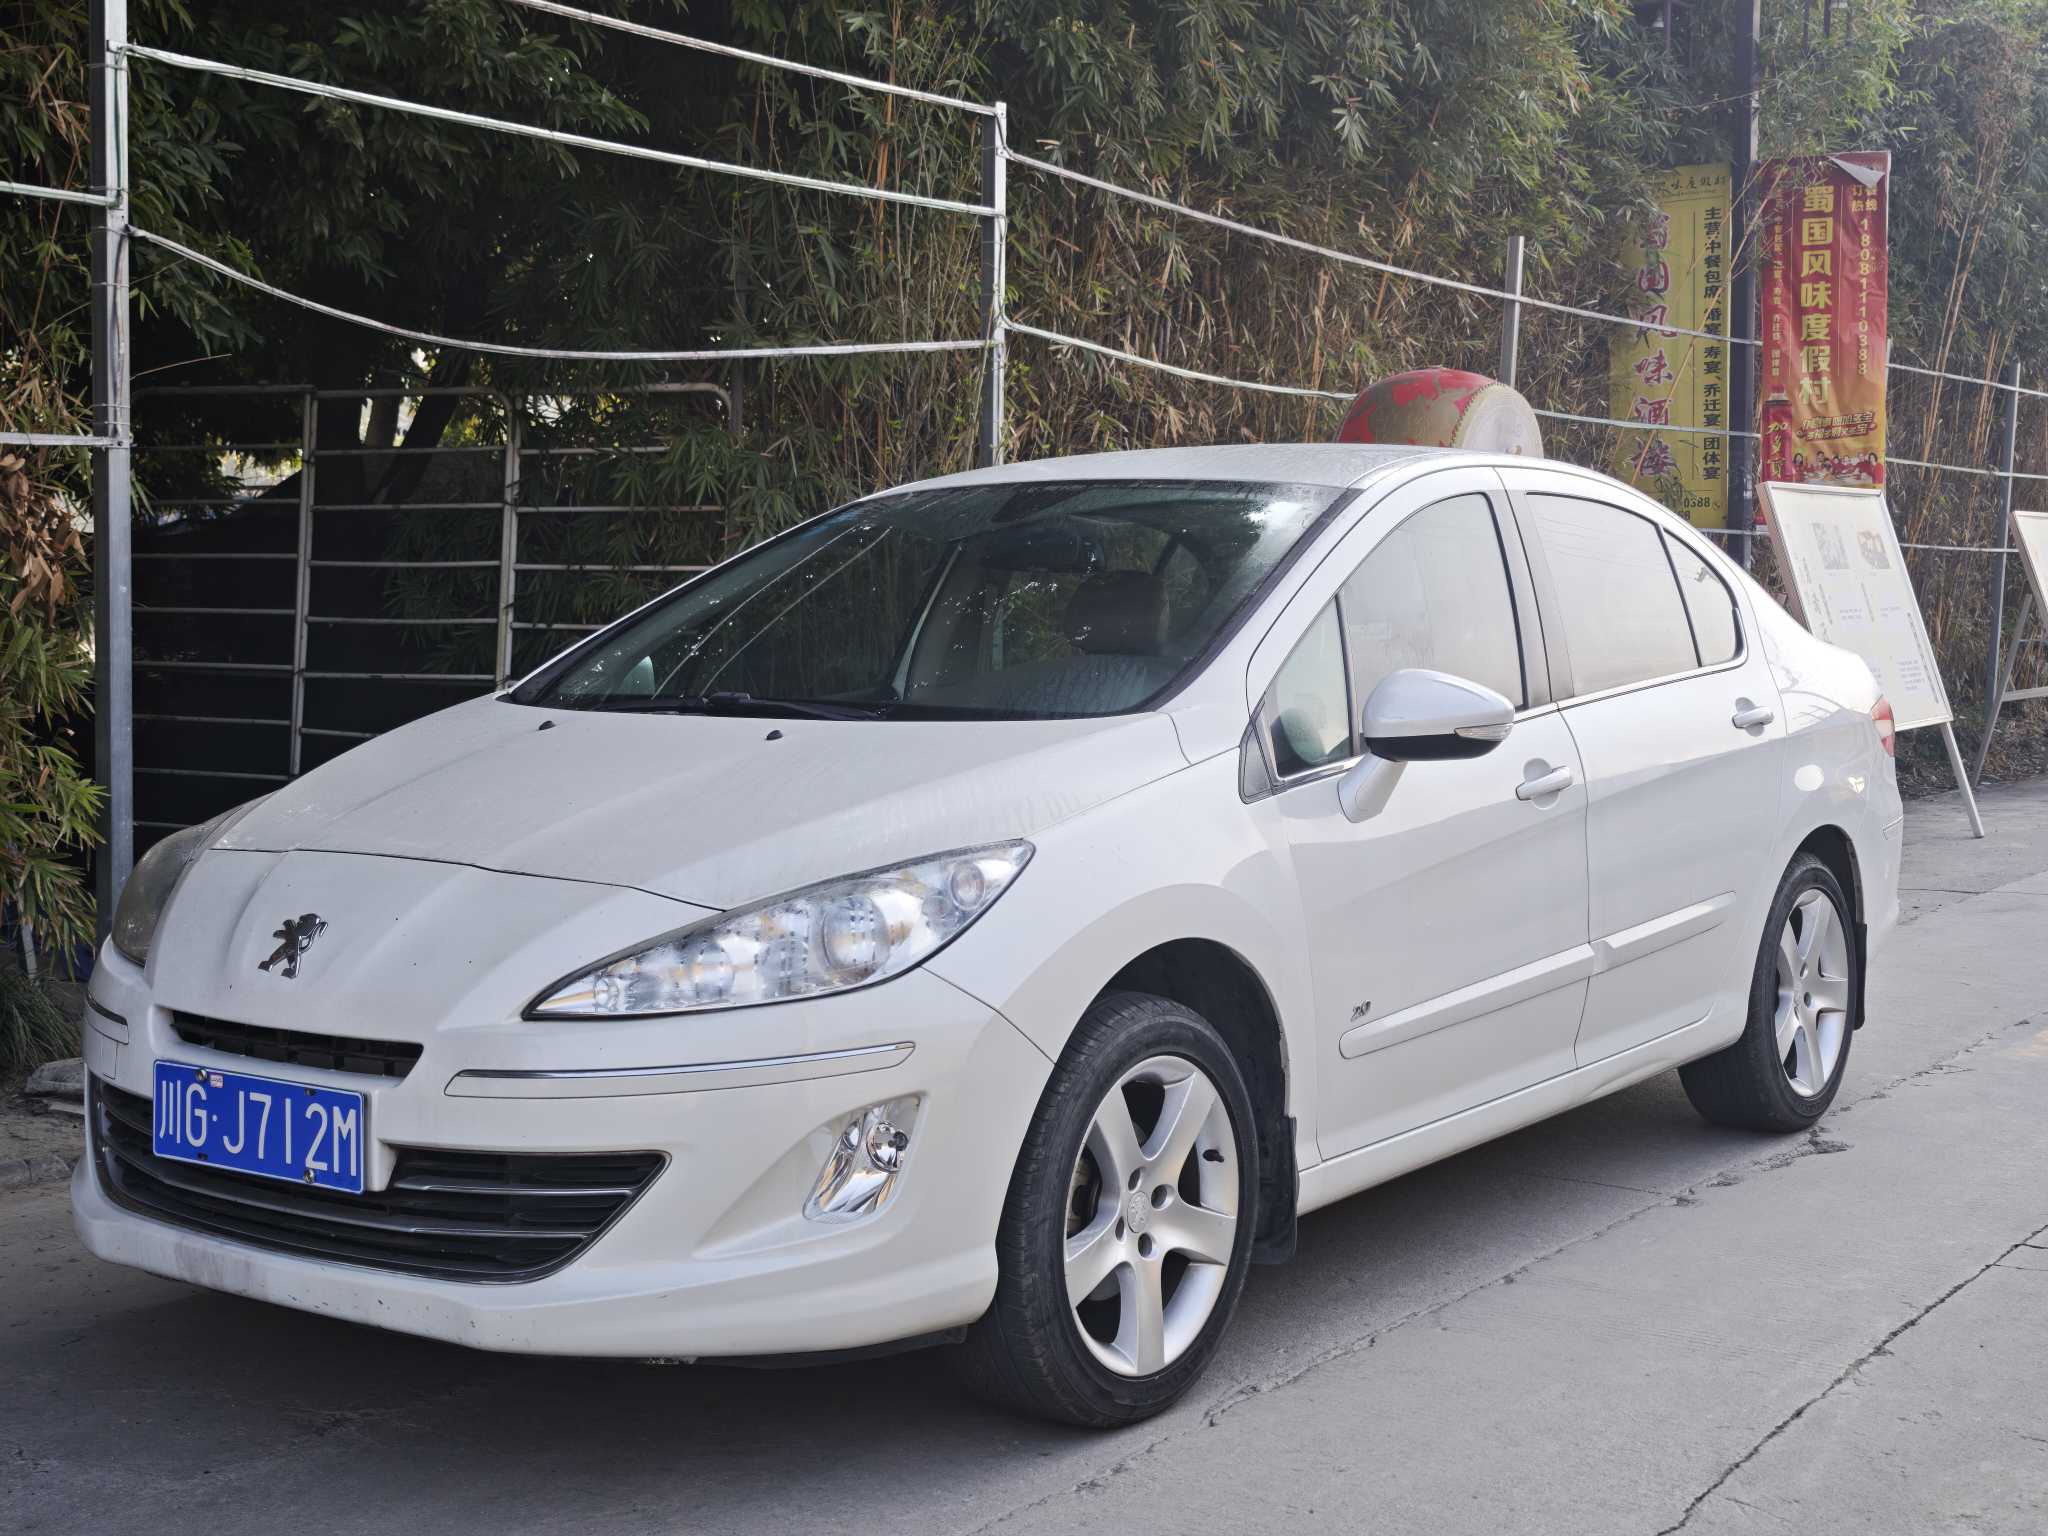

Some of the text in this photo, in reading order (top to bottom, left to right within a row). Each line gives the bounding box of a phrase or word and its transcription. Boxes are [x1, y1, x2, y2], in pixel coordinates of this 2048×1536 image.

[1800, 185, 1834, 405] 蜀国风味度假村
